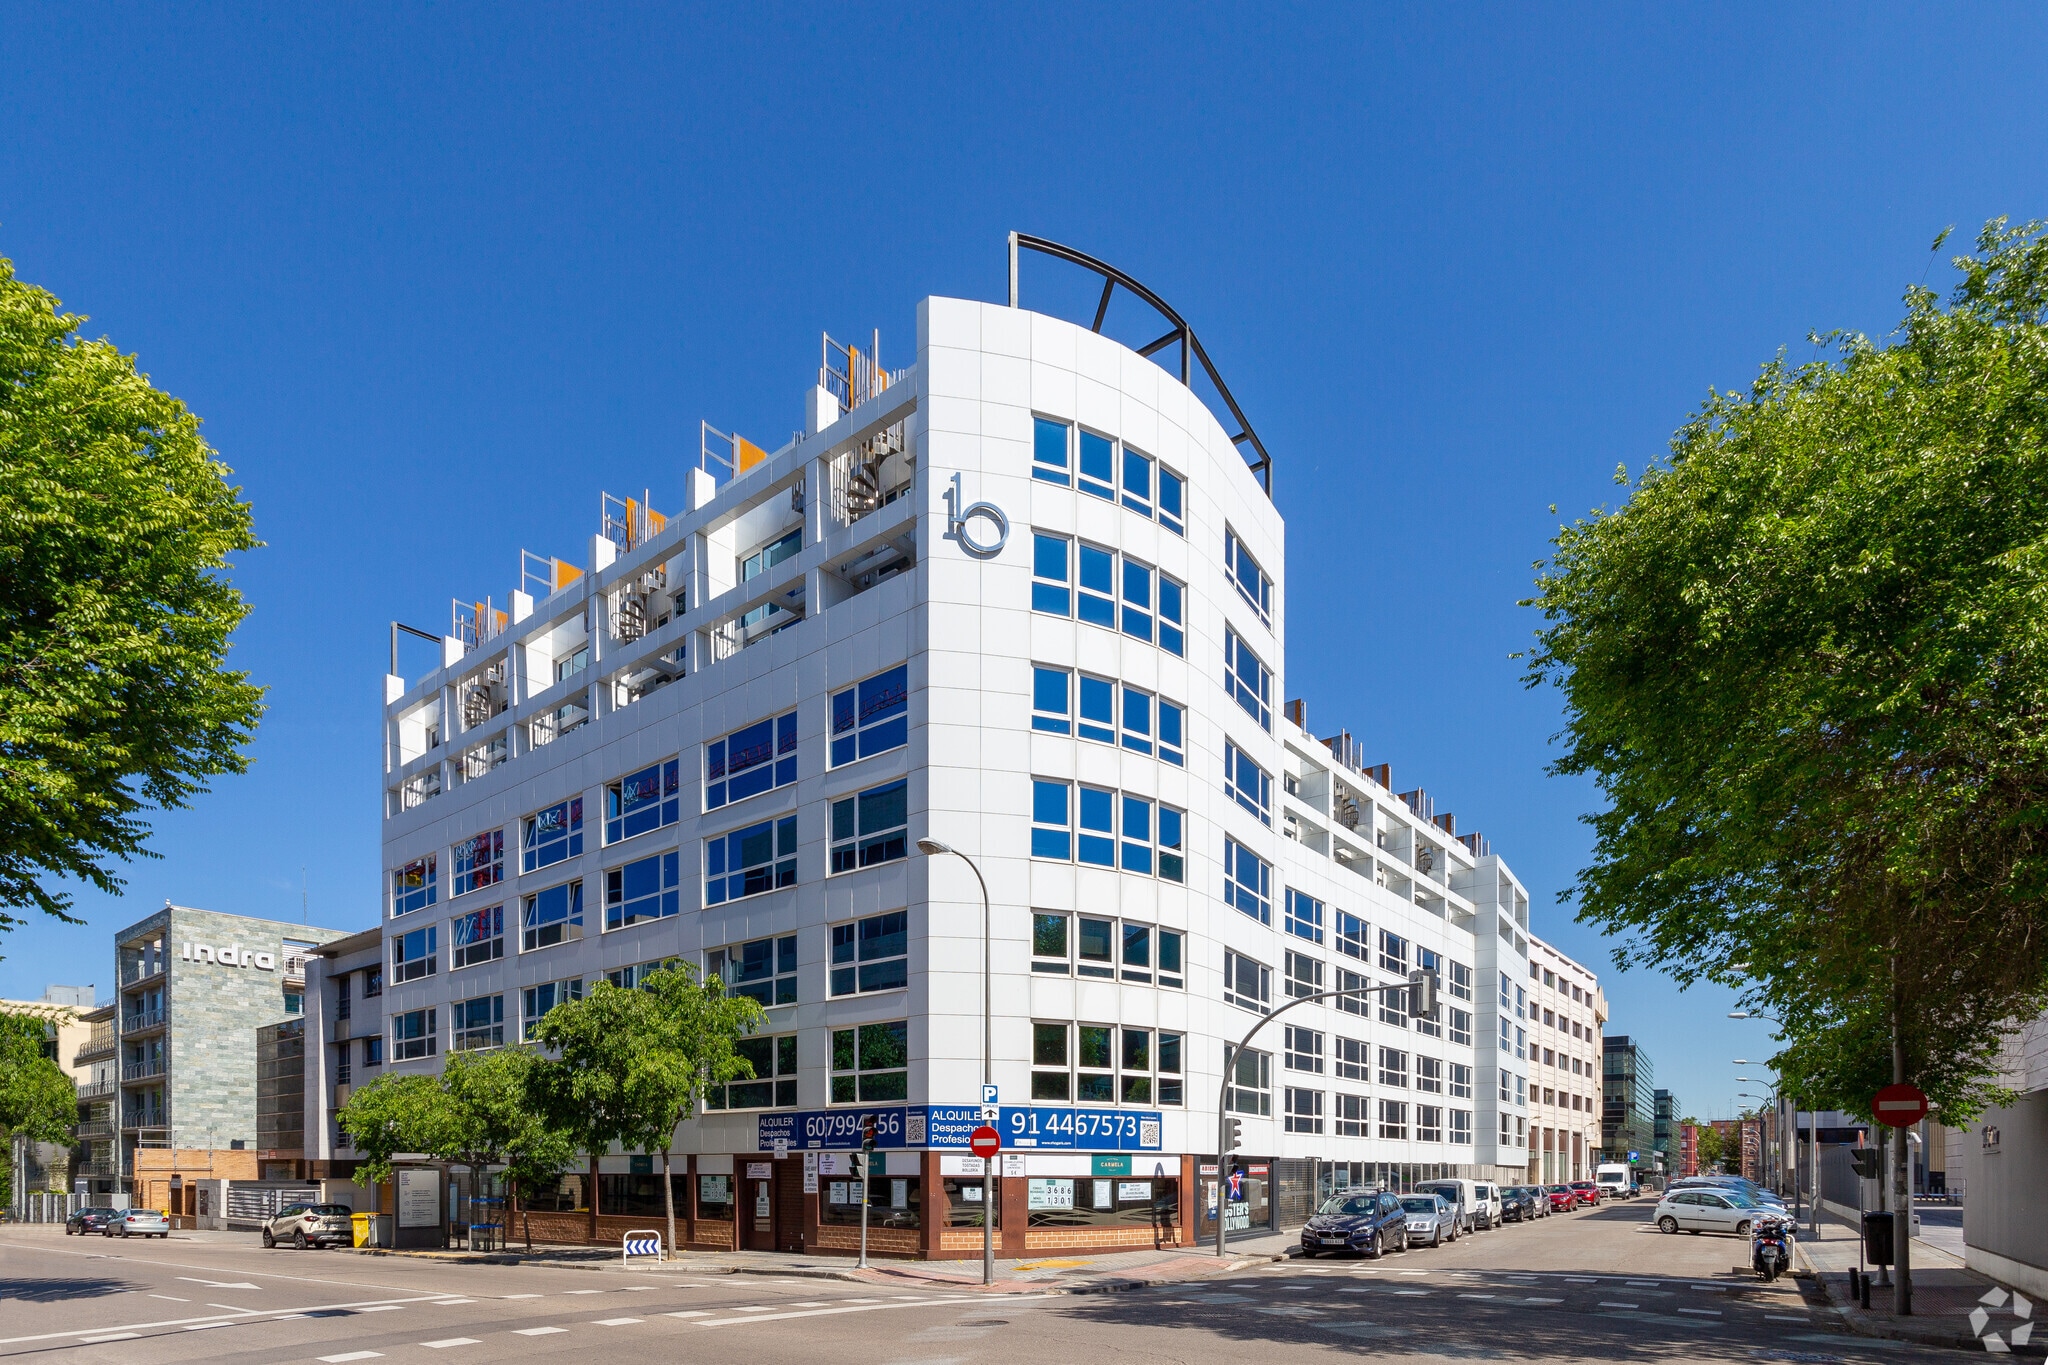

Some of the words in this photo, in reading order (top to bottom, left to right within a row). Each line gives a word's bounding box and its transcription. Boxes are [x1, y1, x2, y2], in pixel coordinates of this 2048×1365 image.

[932, 1111, 981, 1121] ALQUILE
[760, 1117, 794, 1127] ALQUILER
[806, 1113, 899, 1137] 60799456
[1012, 1112, 1040, 1134] 91
[1045, 1113, 1137, 1137] 4467573
[760, 1129, 791, 1138] Despachos
[1047, 1186, 1072, 1195] 3686
